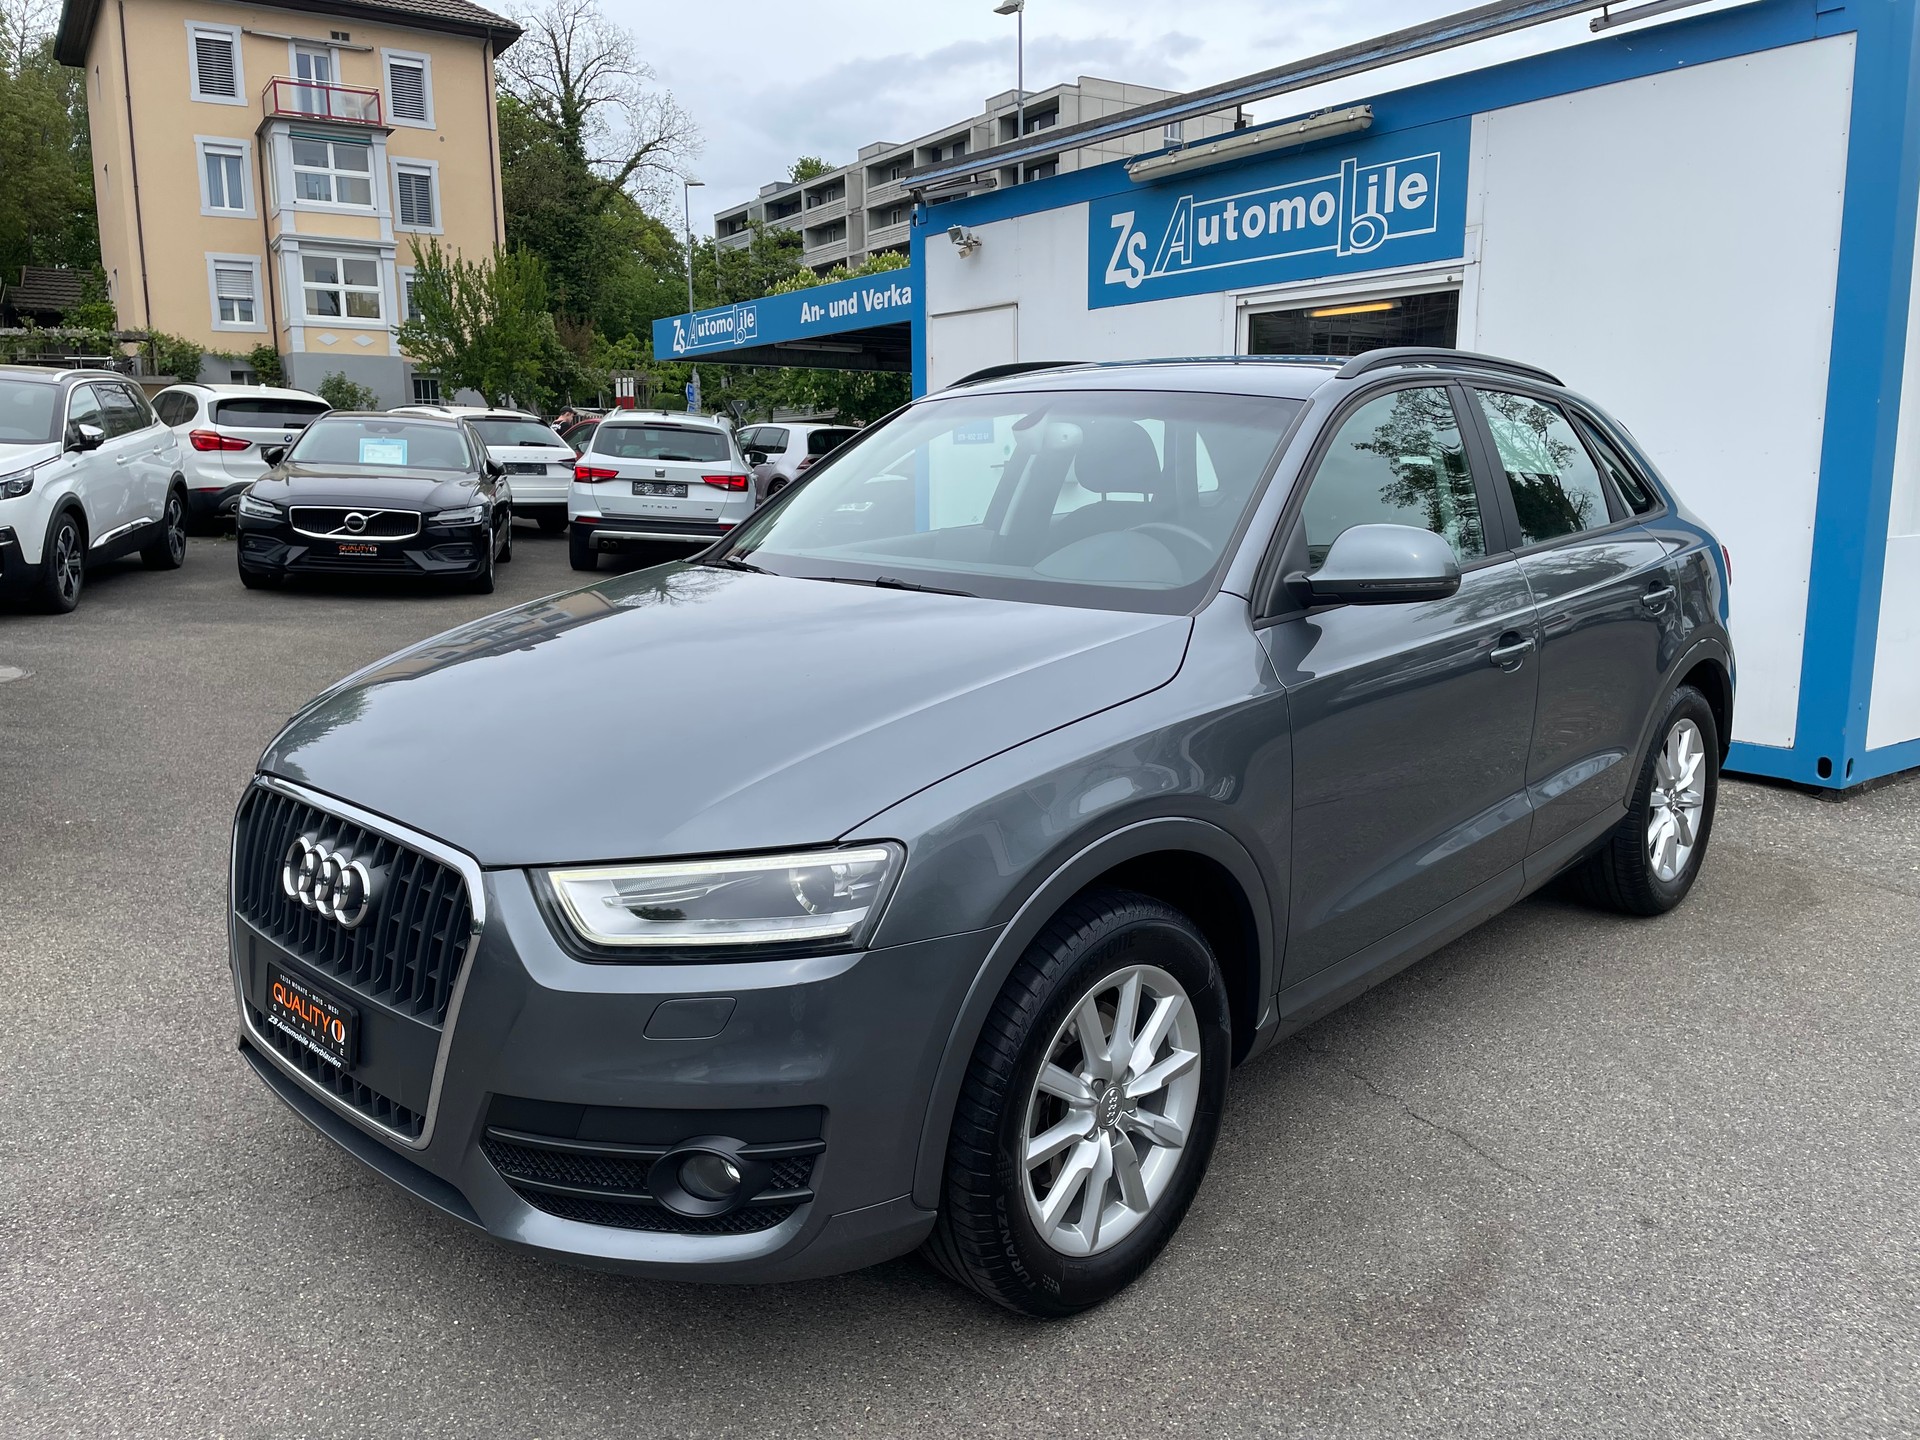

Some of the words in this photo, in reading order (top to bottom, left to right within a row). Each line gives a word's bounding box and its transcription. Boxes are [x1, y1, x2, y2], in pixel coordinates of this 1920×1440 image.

[1150, 156, 1429, 276] Automobile
[686, 305, 755, 349] Automobile
[800, 301, 825, 324] An-
[829, 292, 858, 319] und
[272, 1003, 345, 1057] GARANTIE
[273, 982, 331, 1033] QUALITY
[268, 1014, 279, 1026] ZS
[277, 1021, 309, 1046] Automobile
[309, 1041, 342, 1069] Worblaufen
[996, 1195, 1036, 1289] TURANZA
